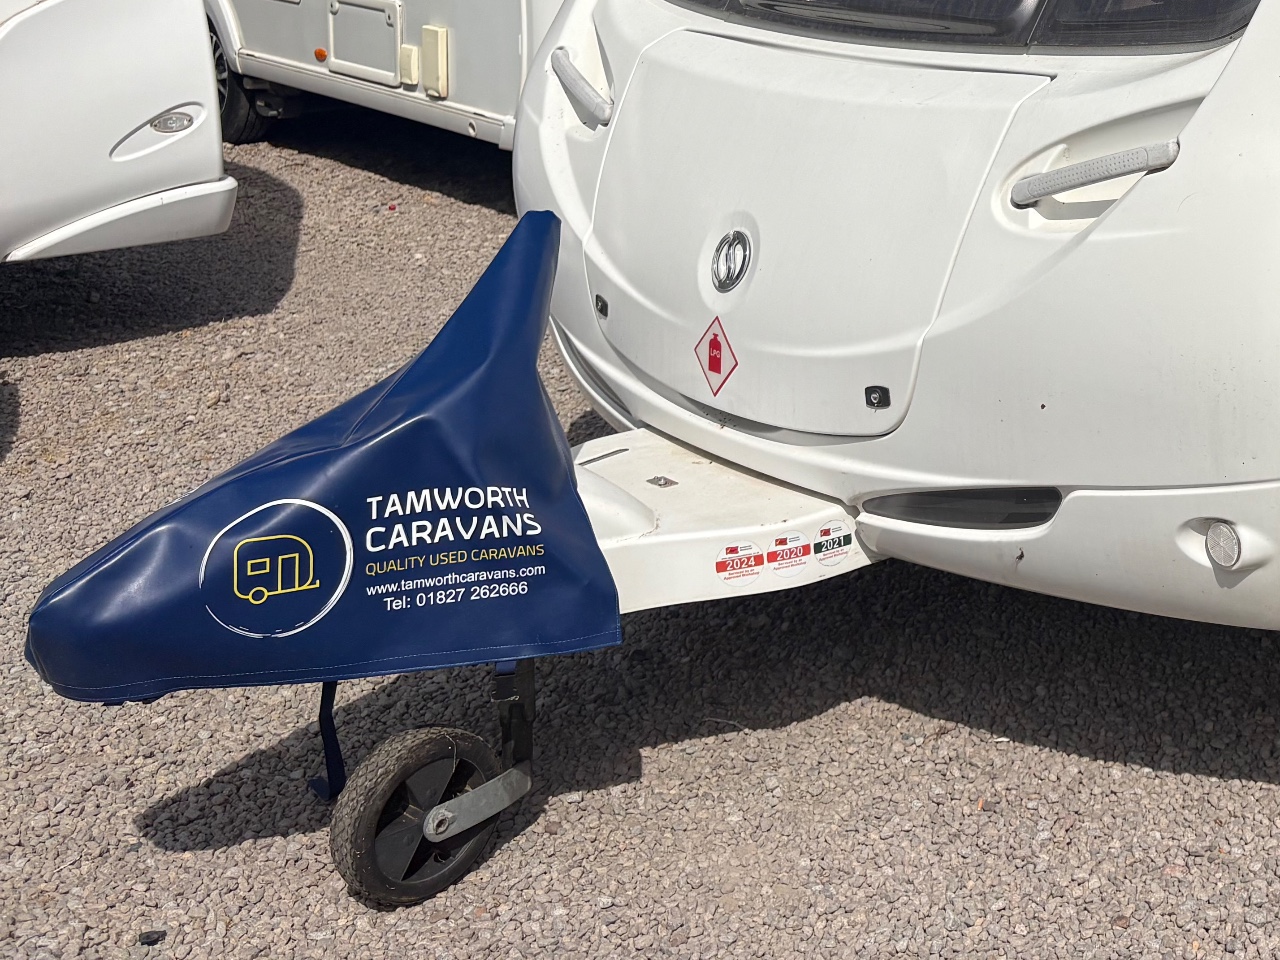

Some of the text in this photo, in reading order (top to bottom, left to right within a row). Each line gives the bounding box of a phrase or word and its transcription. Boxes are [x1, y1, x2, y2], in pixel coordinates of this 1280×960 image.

[710, 348, 721, 358] LPG
[366, 486, 530, 519] TAMWORTH
[366, 513, 542, 552] CARAVANS
[821, 536, 844, 551] 2021
[365, 544, 545, 576] QUALITY USED CARAVANS
[726, 556, 755, 571] 2024
[776, 546, 803, 561] 2020
[366, 565, 546, 596] www.tamworthcaravans.com
[383, 581, 528, 611] Tel: 01827 262666
